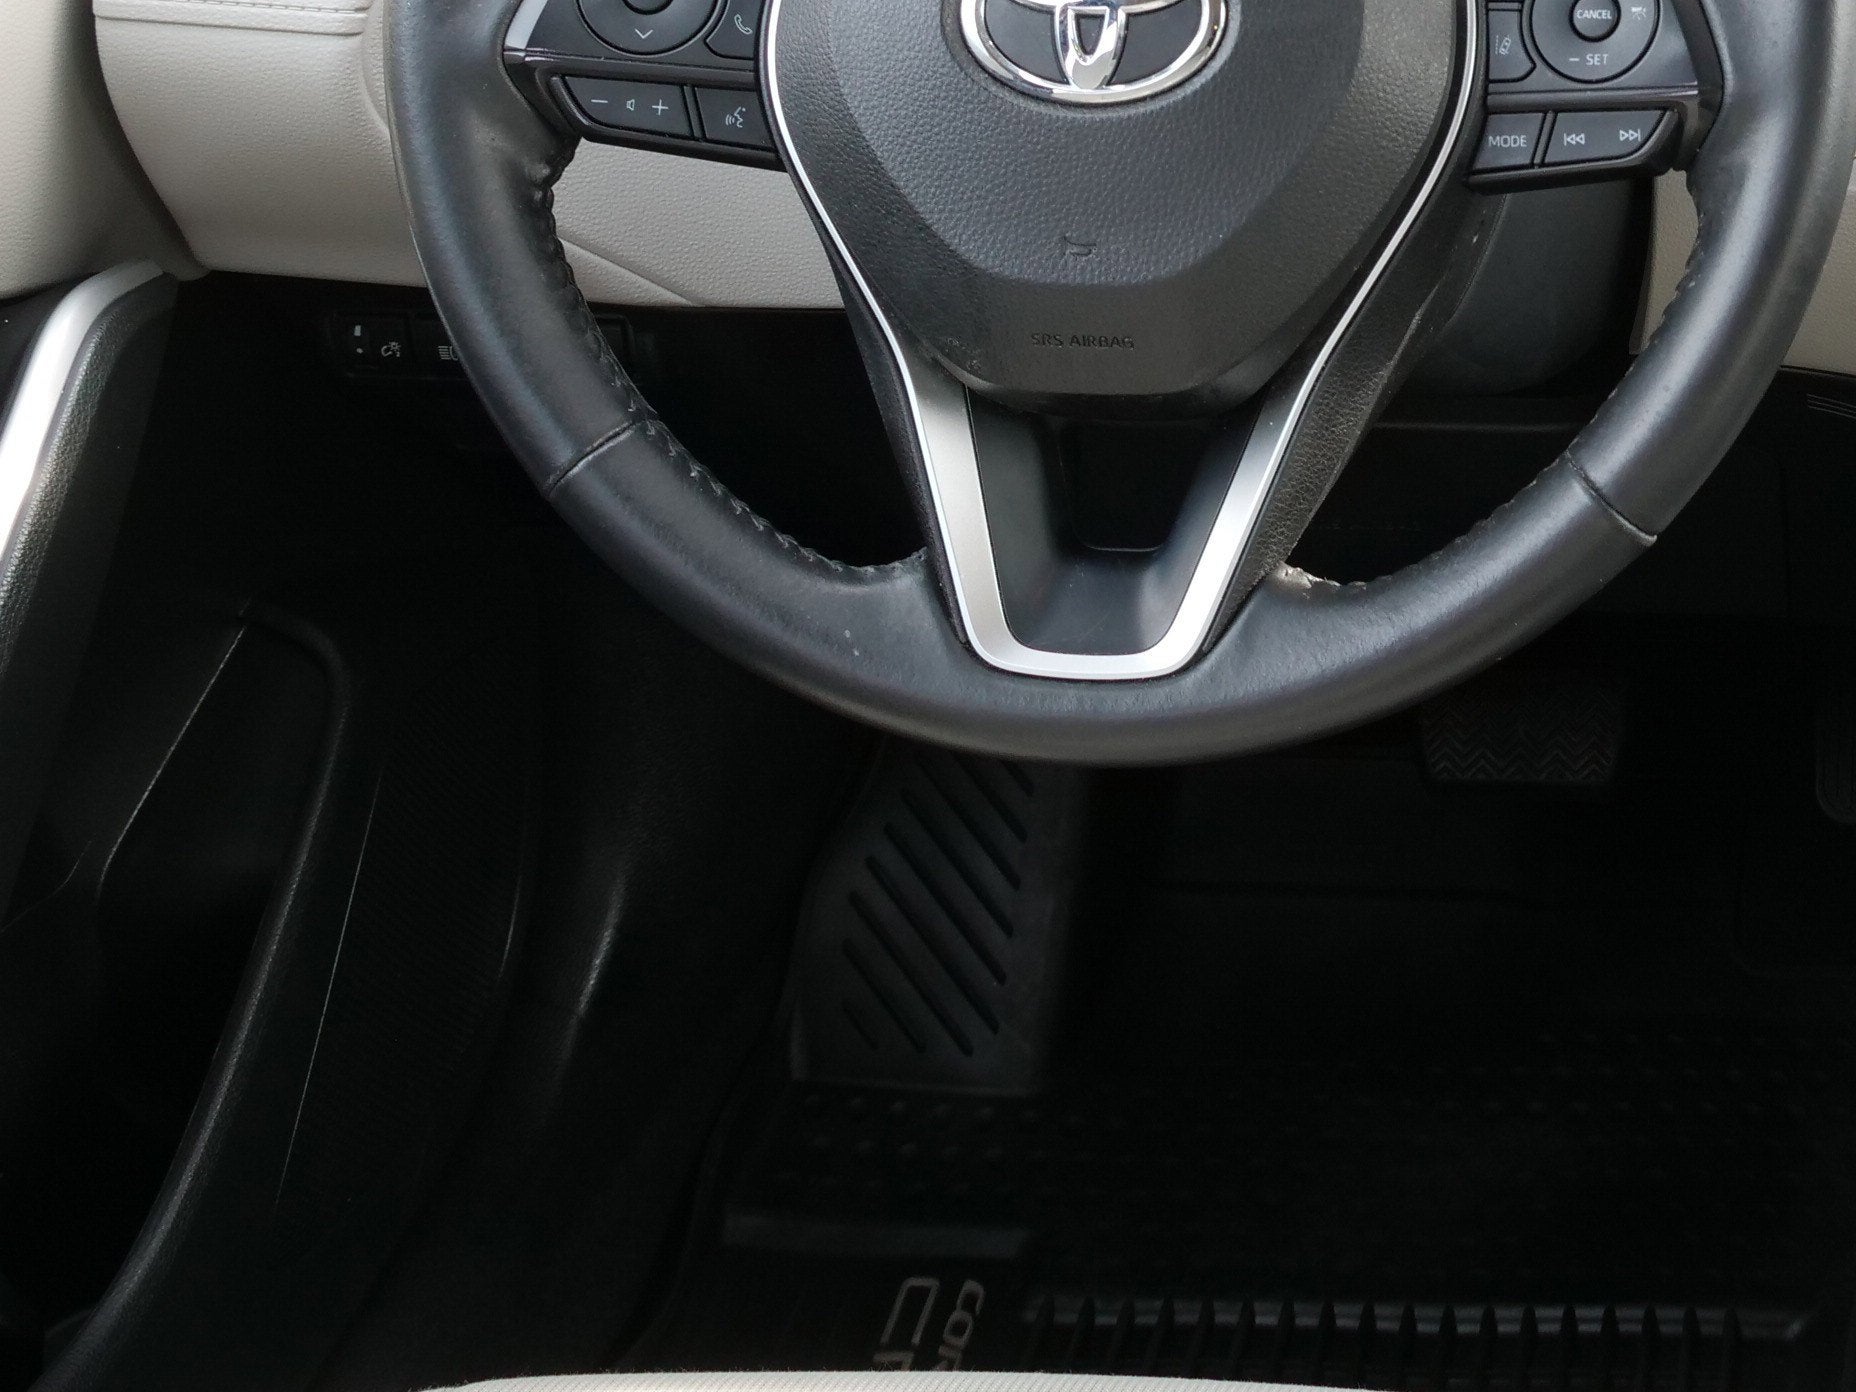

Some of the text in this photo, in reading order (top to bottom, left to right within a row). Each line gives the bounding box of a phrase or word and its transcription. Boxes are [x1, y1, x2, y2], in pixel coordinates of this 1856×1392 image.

[1576, 9, 1612, 20] CANCEL
[1586, 53, 1609, 66] SET
[1488, 135, 1527, 149] MODE
[1031, 333, 1135, 350] SRS AIRBAG
